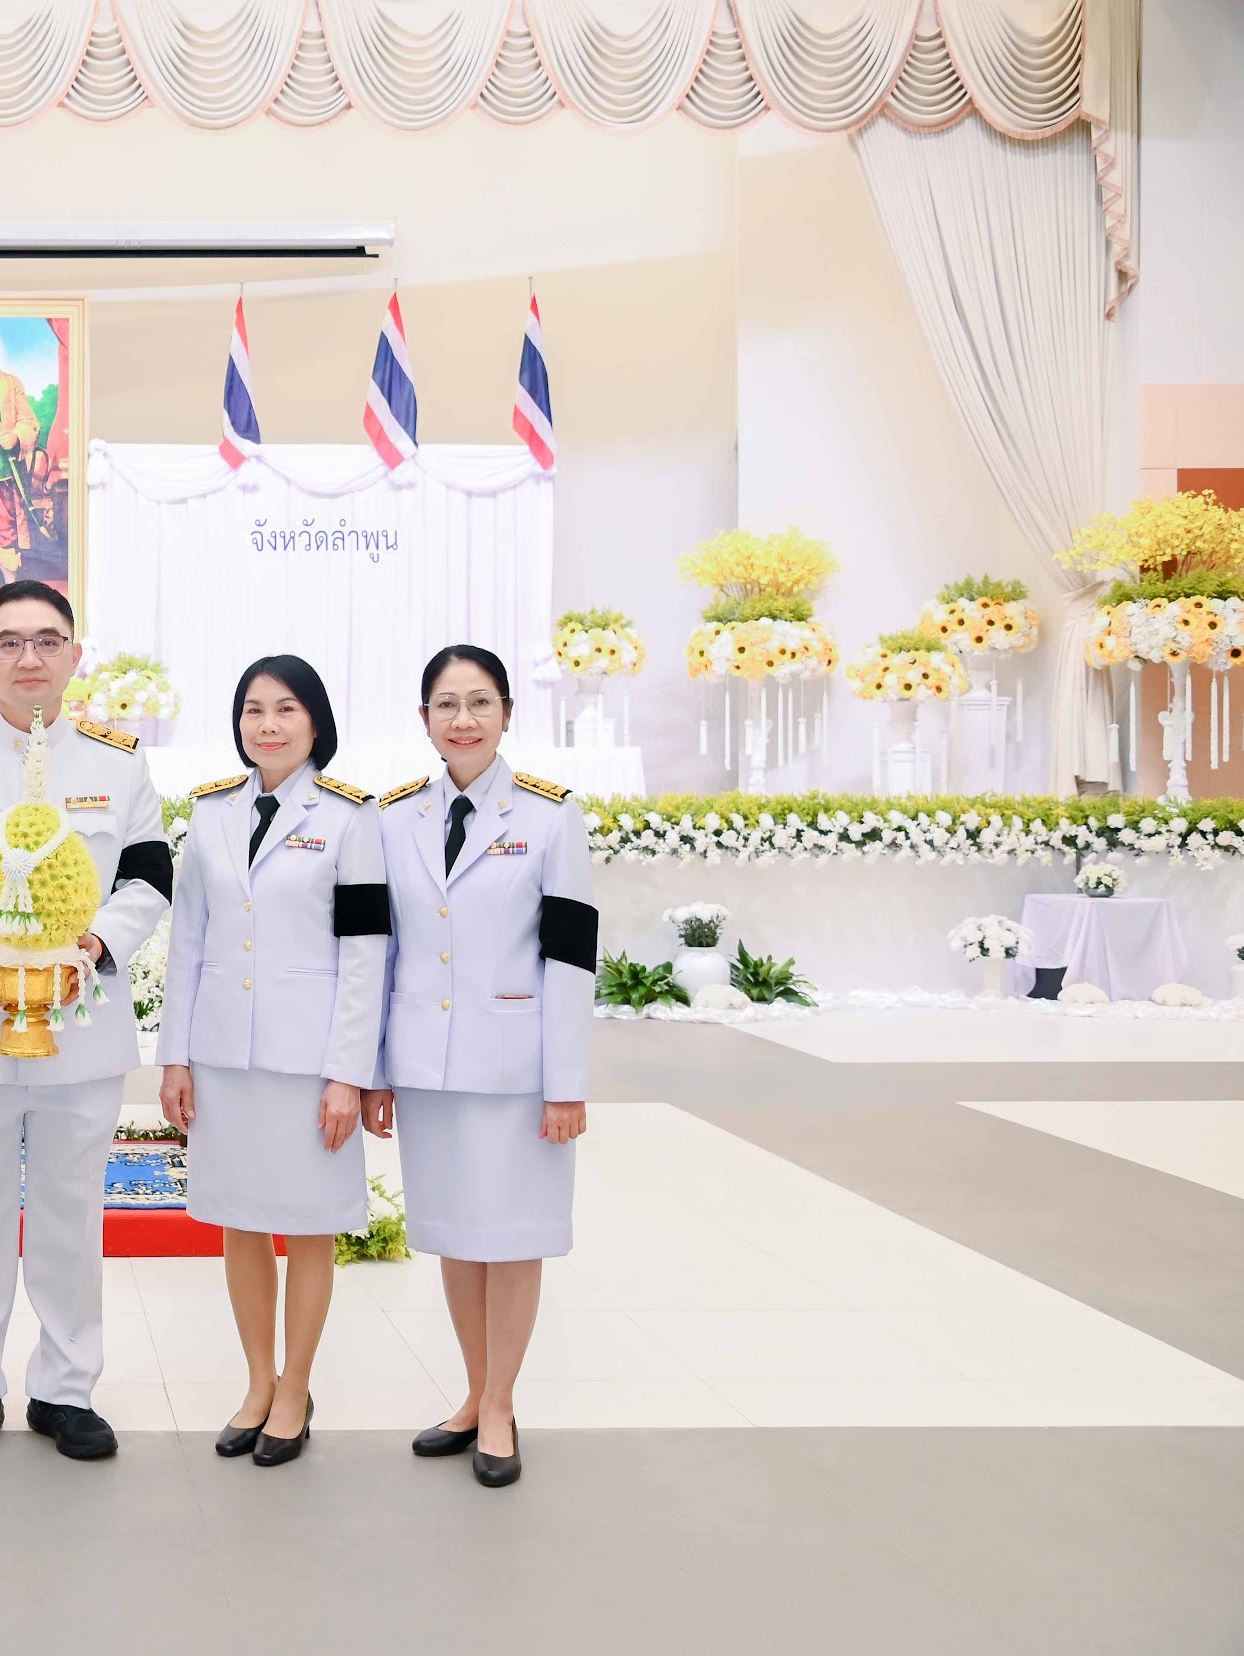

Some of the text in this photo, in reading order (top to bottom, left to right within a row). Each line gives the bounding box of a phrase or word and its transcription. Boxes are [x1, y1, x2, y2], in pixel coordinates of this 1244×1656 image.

[250, 518, 399, 563] จังหวัดลำพูน
